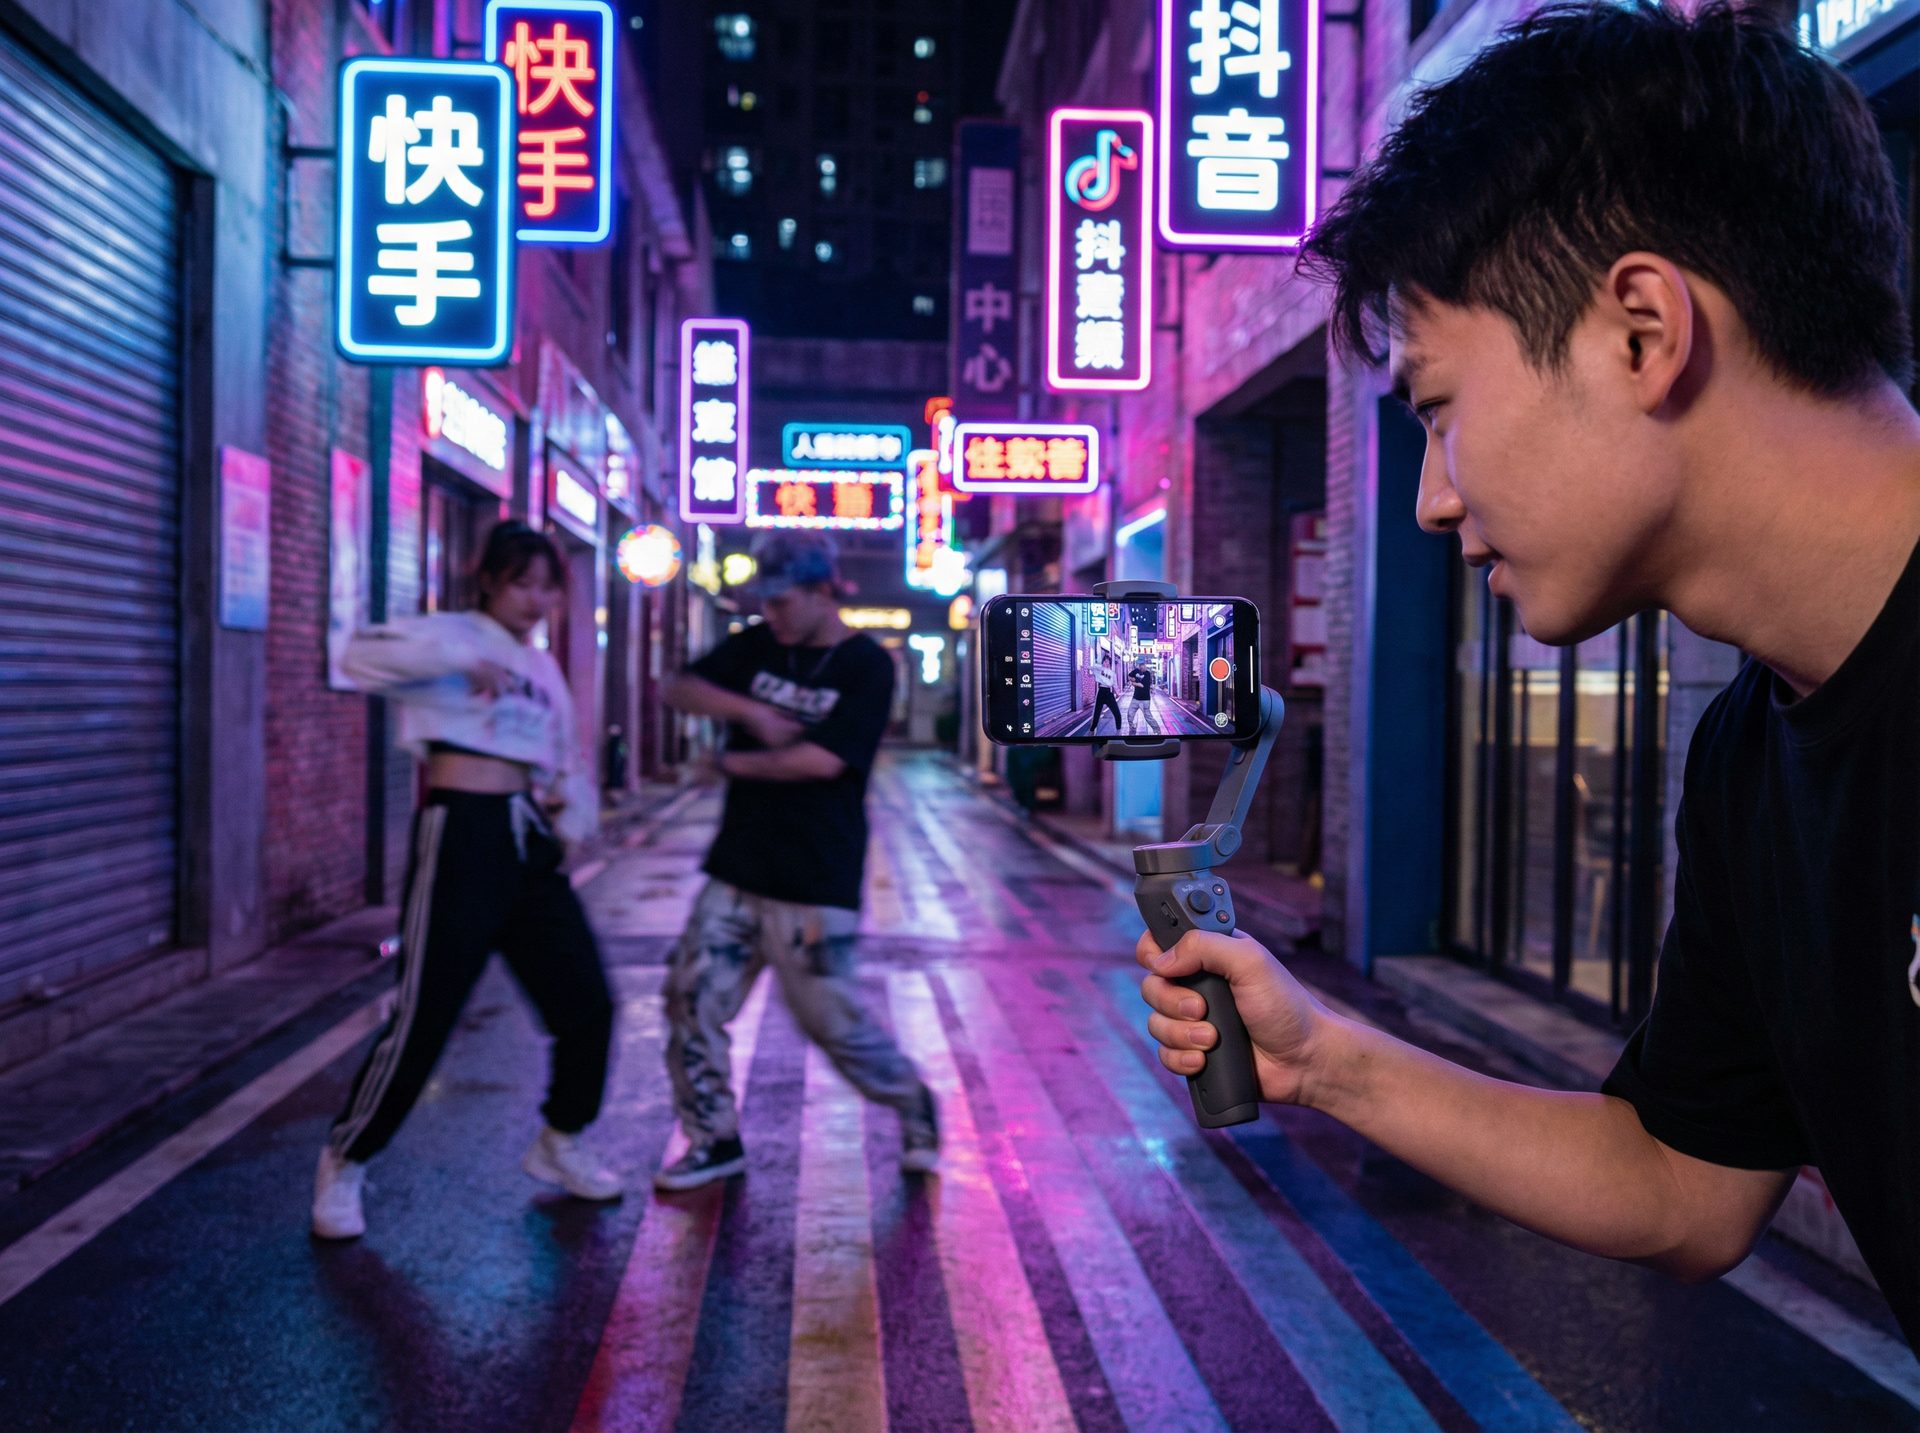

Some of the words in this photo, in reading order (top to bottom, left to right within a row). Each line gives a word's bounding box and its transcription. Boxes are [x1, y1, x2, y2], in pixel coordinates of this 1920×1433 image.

[368, 94, 485, 326] 快手
[505, 22, 596, 217] 快手
[1187, 0, 1292, 211] 抖音
